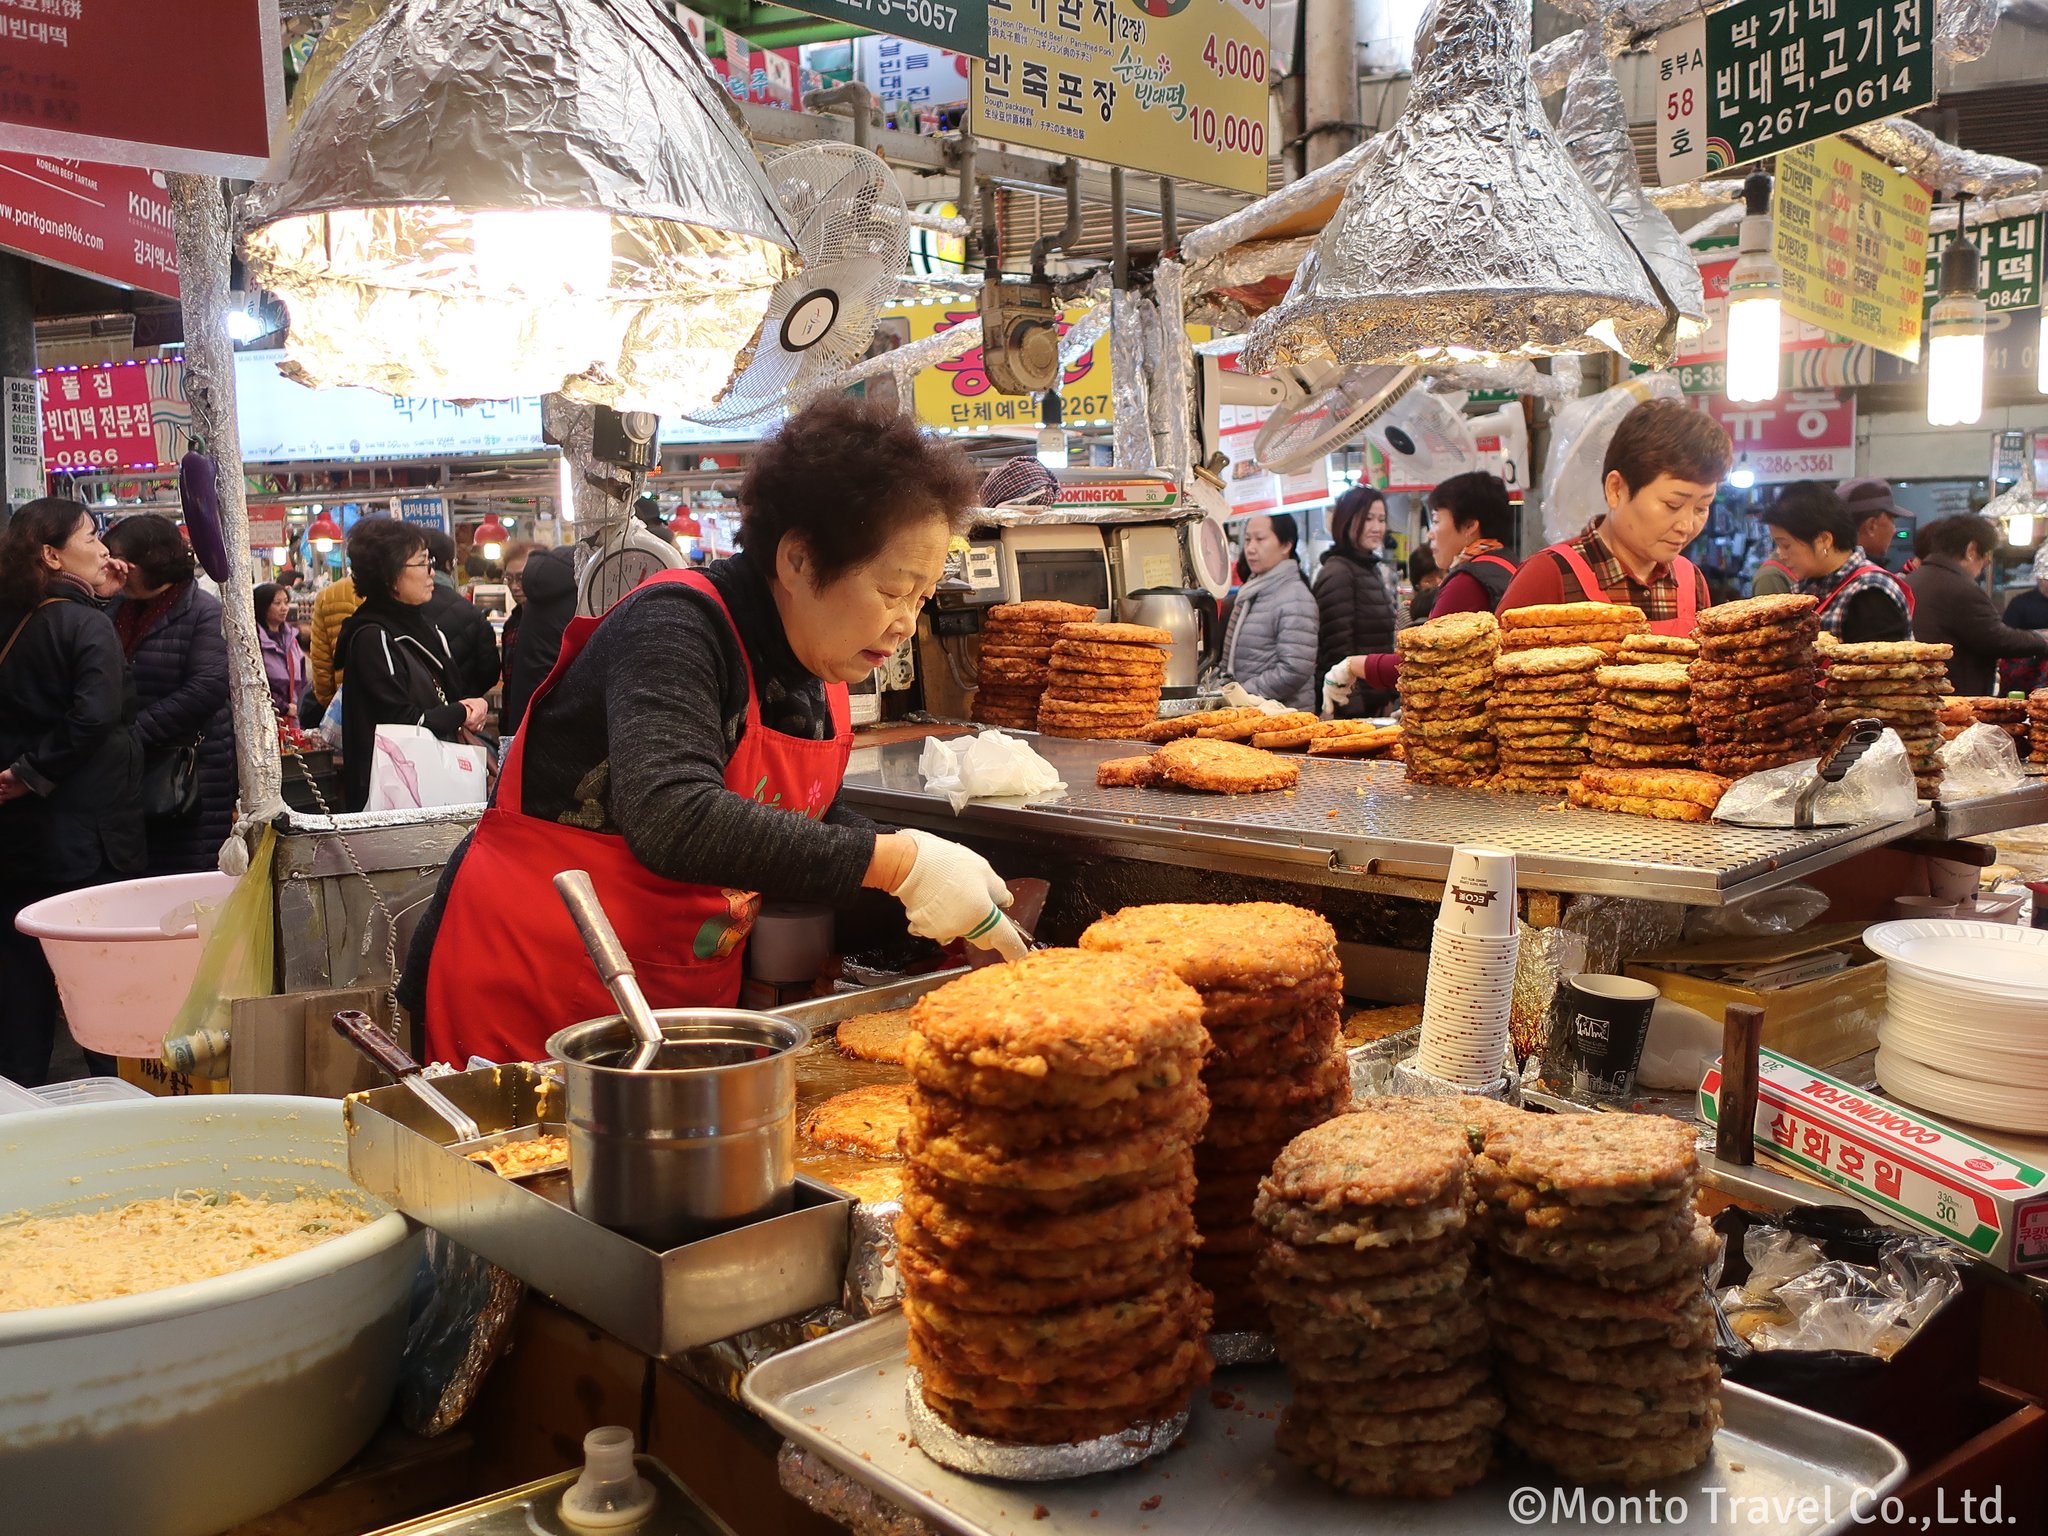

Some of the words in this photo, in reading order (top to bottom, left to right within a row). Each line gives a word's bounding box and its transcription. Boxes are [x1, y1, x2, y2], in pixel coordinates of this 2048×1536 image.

[1050, 32, 1064, 42] Beef
[1731, 0, 1836, 49] 박가네
[1203, 34, 1266, 83] 4,000
[1660, 48, 1703, 81] 동부A
[984, 54, 1117, 122] 반죽포장
[984, 95, 1004, 108] Dough
[1135, 83, 1188, 122] 빈대떡
[1667, 87, 1694, 121] 58
[1738, 67, 1912, 149] 2267-0614
[1189, 106, 1264, 156] 10,000
[1669, 128, 1693, 158] 호
[36, 158, 60, 177] KOREAN
[60, 167, 74, 182] BEEF
[74, 174, 98, 191] TARTARE
[100, 403, 150, 438] 전문점
[951, 400, 1037, 422] 단체예약
[1800, 1080, 1847, 1105] FOIL
[1839, 1095, 1942, 1145] COOKING
[1770, 1113, 1904, 1200] 삼화호일
